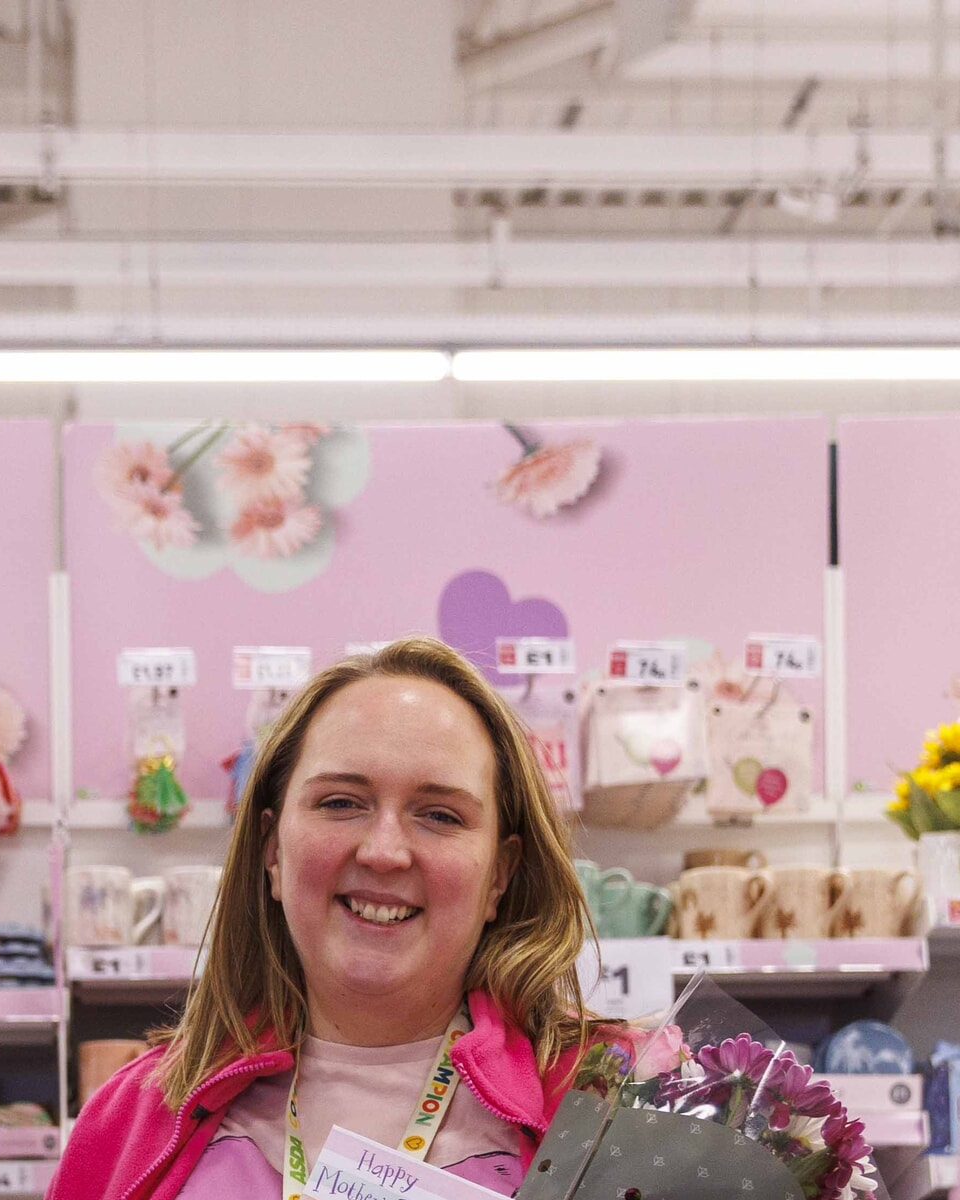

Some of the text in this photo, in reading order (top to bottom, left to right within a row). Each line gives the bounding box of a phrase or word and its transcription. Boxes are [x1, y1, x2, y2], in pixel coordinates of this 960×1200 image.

[414, 1029, 464, 1128] CAMPION
[289, 1135, 307, 1186] ASDA
[356, 1149, 419, 1193] Happy
